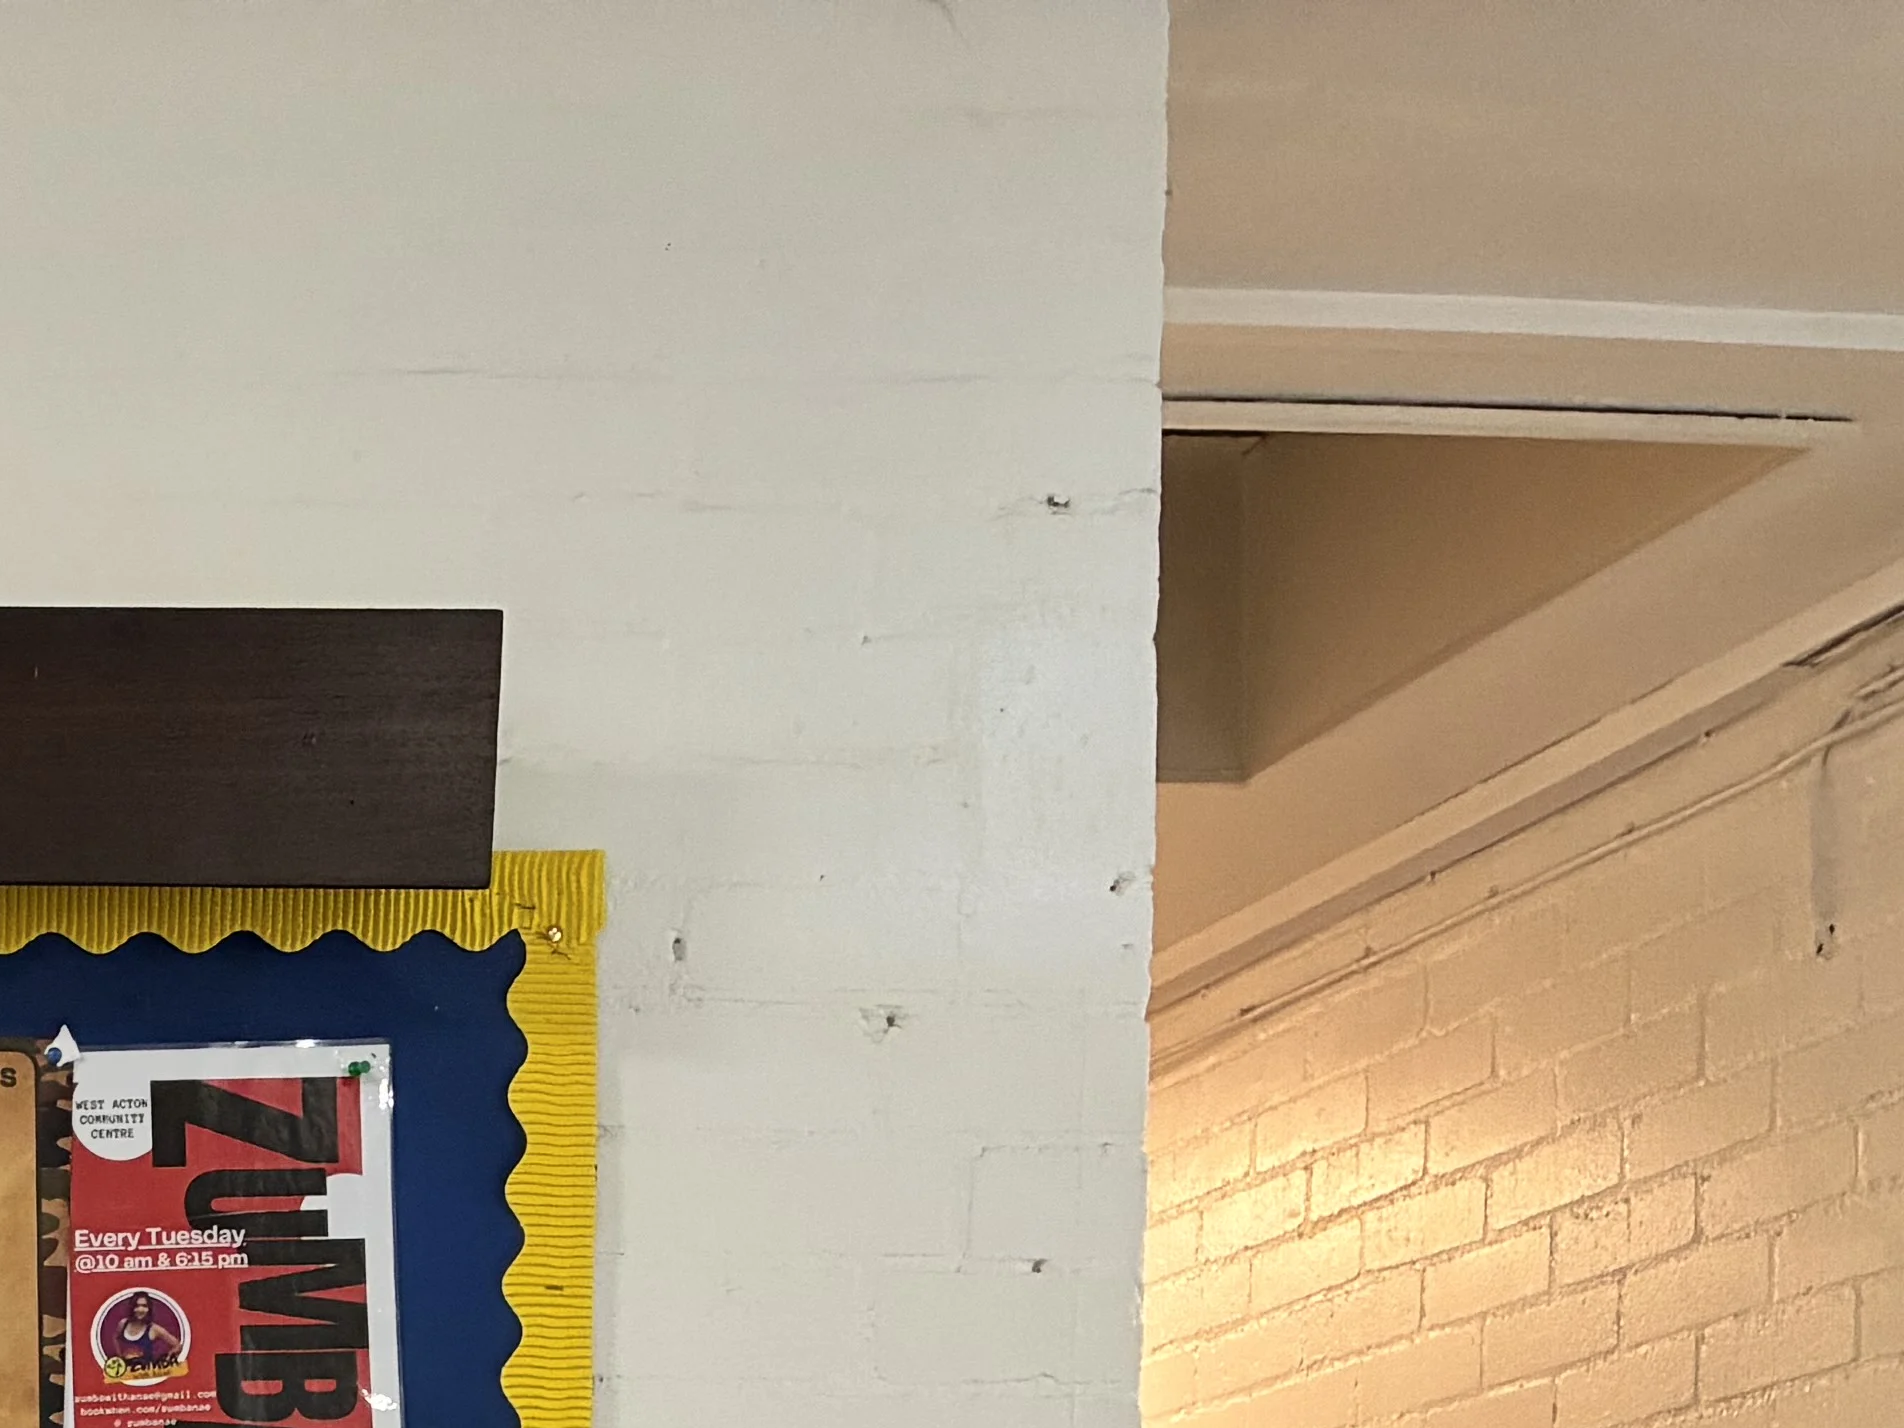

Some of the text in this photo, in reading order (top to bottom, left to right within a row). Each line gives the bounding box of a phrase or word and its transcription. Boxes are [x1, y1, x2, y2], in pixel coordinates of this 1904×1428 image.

[75, 1099, 148, 1111] WEST ACTON
[79, 1114, 145, 1126] COMMUNITY
[90, 1128, 135, 1140] CENTRE
[74, 1226, 246, 1250] Every Tuesday
[74, 1252, 248, 1272] @10 am & 6:15 pm
